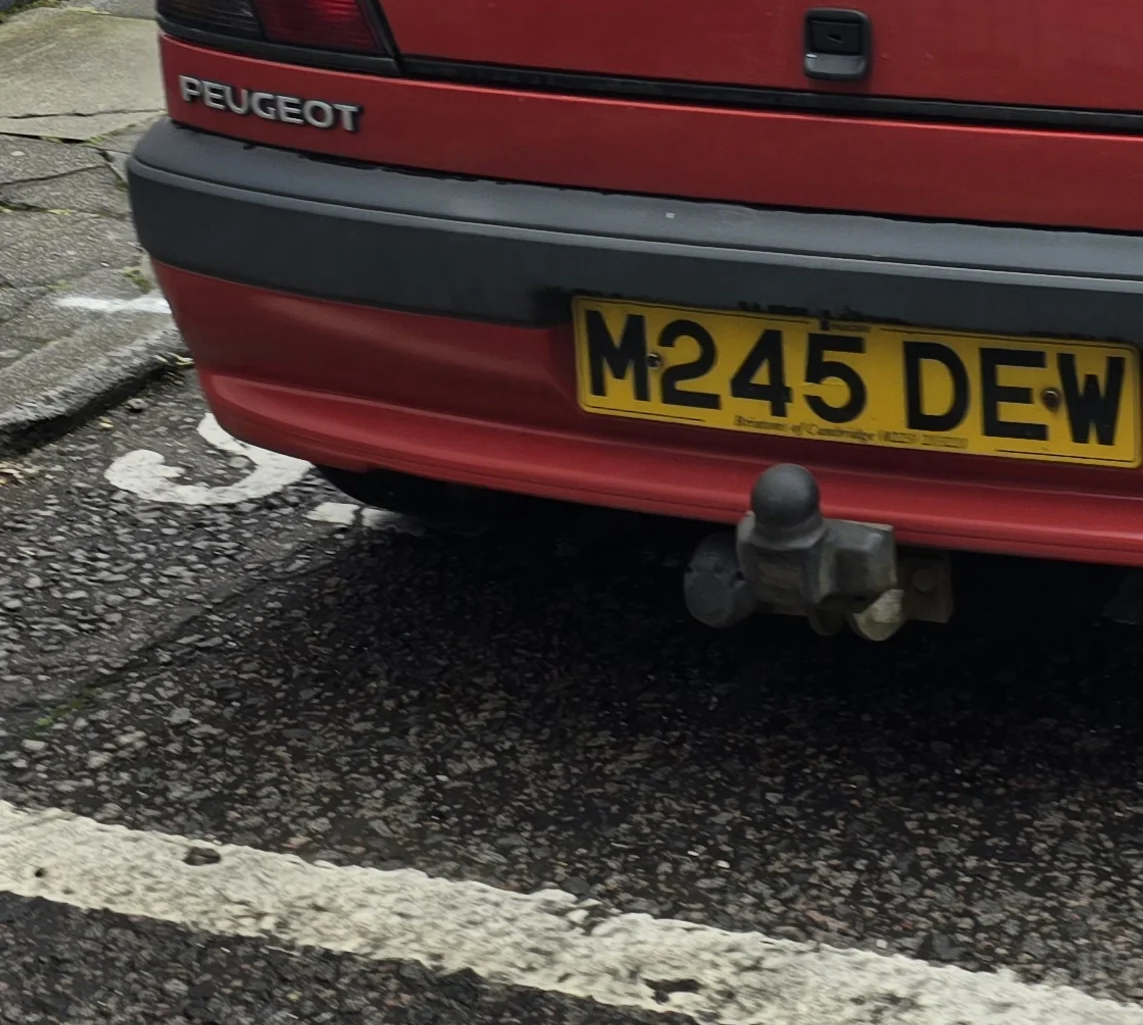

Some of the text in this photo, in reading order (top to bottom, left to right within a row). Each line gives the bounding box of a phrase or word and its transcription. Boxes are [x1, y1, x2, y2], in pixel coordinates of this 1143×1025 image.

[178, 75, 361, 133] PEUGEOT
[585, 310, 1127, 447] M245 DEW
